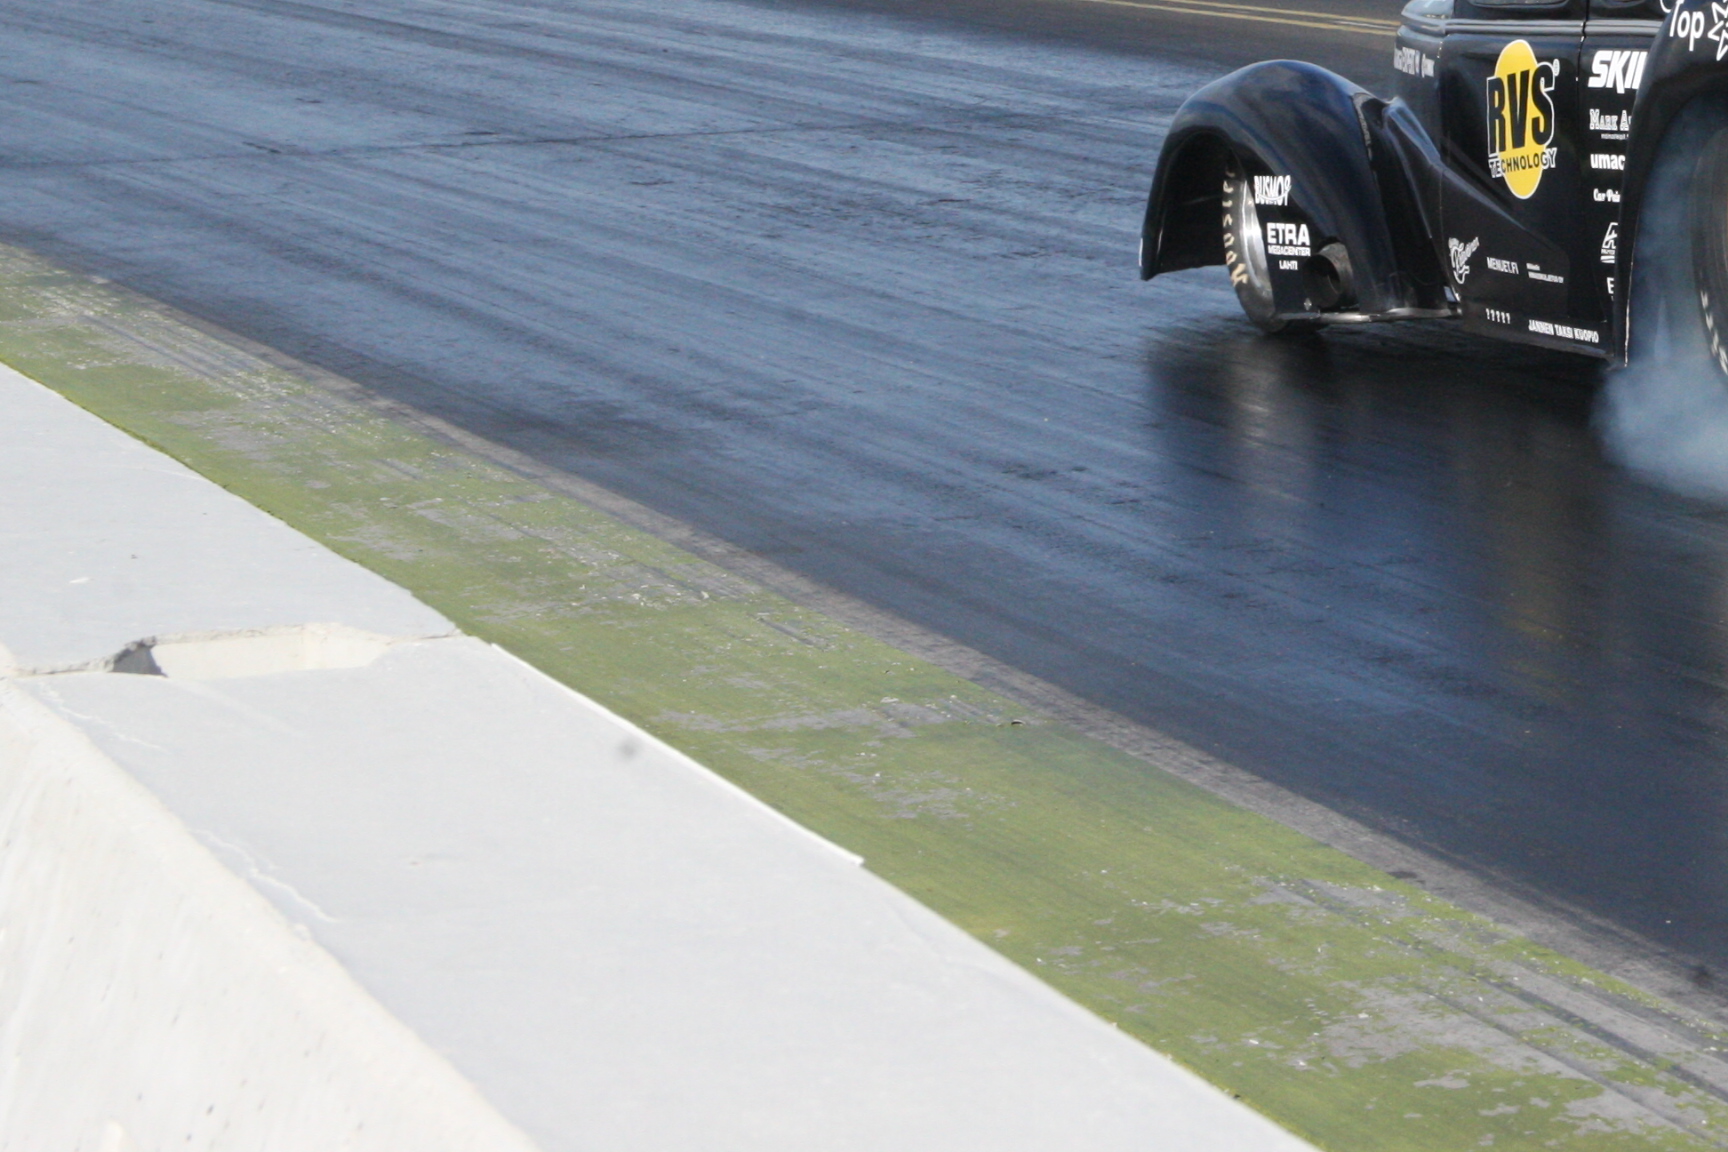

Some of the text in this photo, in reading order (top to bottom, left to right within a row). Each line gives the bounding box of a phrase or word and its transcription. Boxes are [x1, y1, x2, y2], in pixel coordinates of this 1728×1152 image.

[1486, 61, 1555, 158] RVS
[1488, 147, 1558, 179] TECHNOLOGY
[1266, 222, 1310, 246] ETRA
